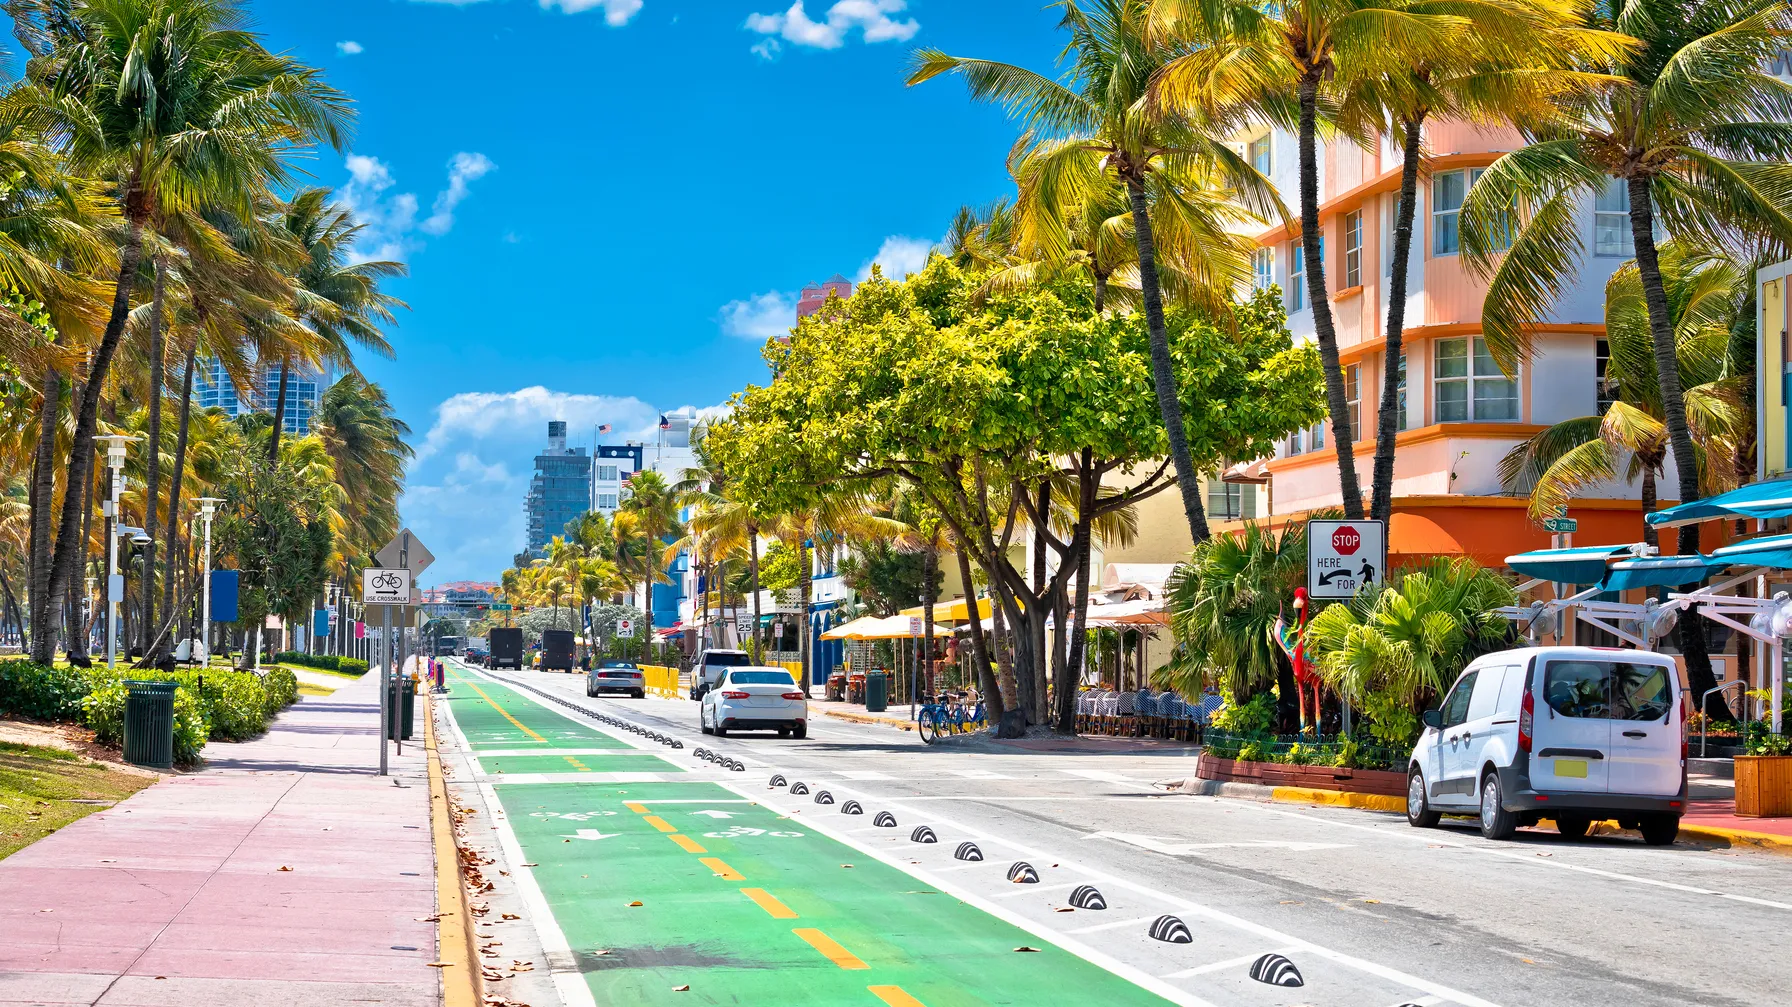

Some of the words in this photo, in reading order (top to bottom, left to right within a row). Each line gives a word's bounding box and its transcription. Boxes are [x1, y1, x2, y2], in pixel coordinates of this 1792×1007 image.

[1560, 522, 1576, 531] STREET
[1333, 535, 1360, 546] STOP
[1317, 558, 1341, 568] HERE
[1337, 579, 1356, 589] FOR
